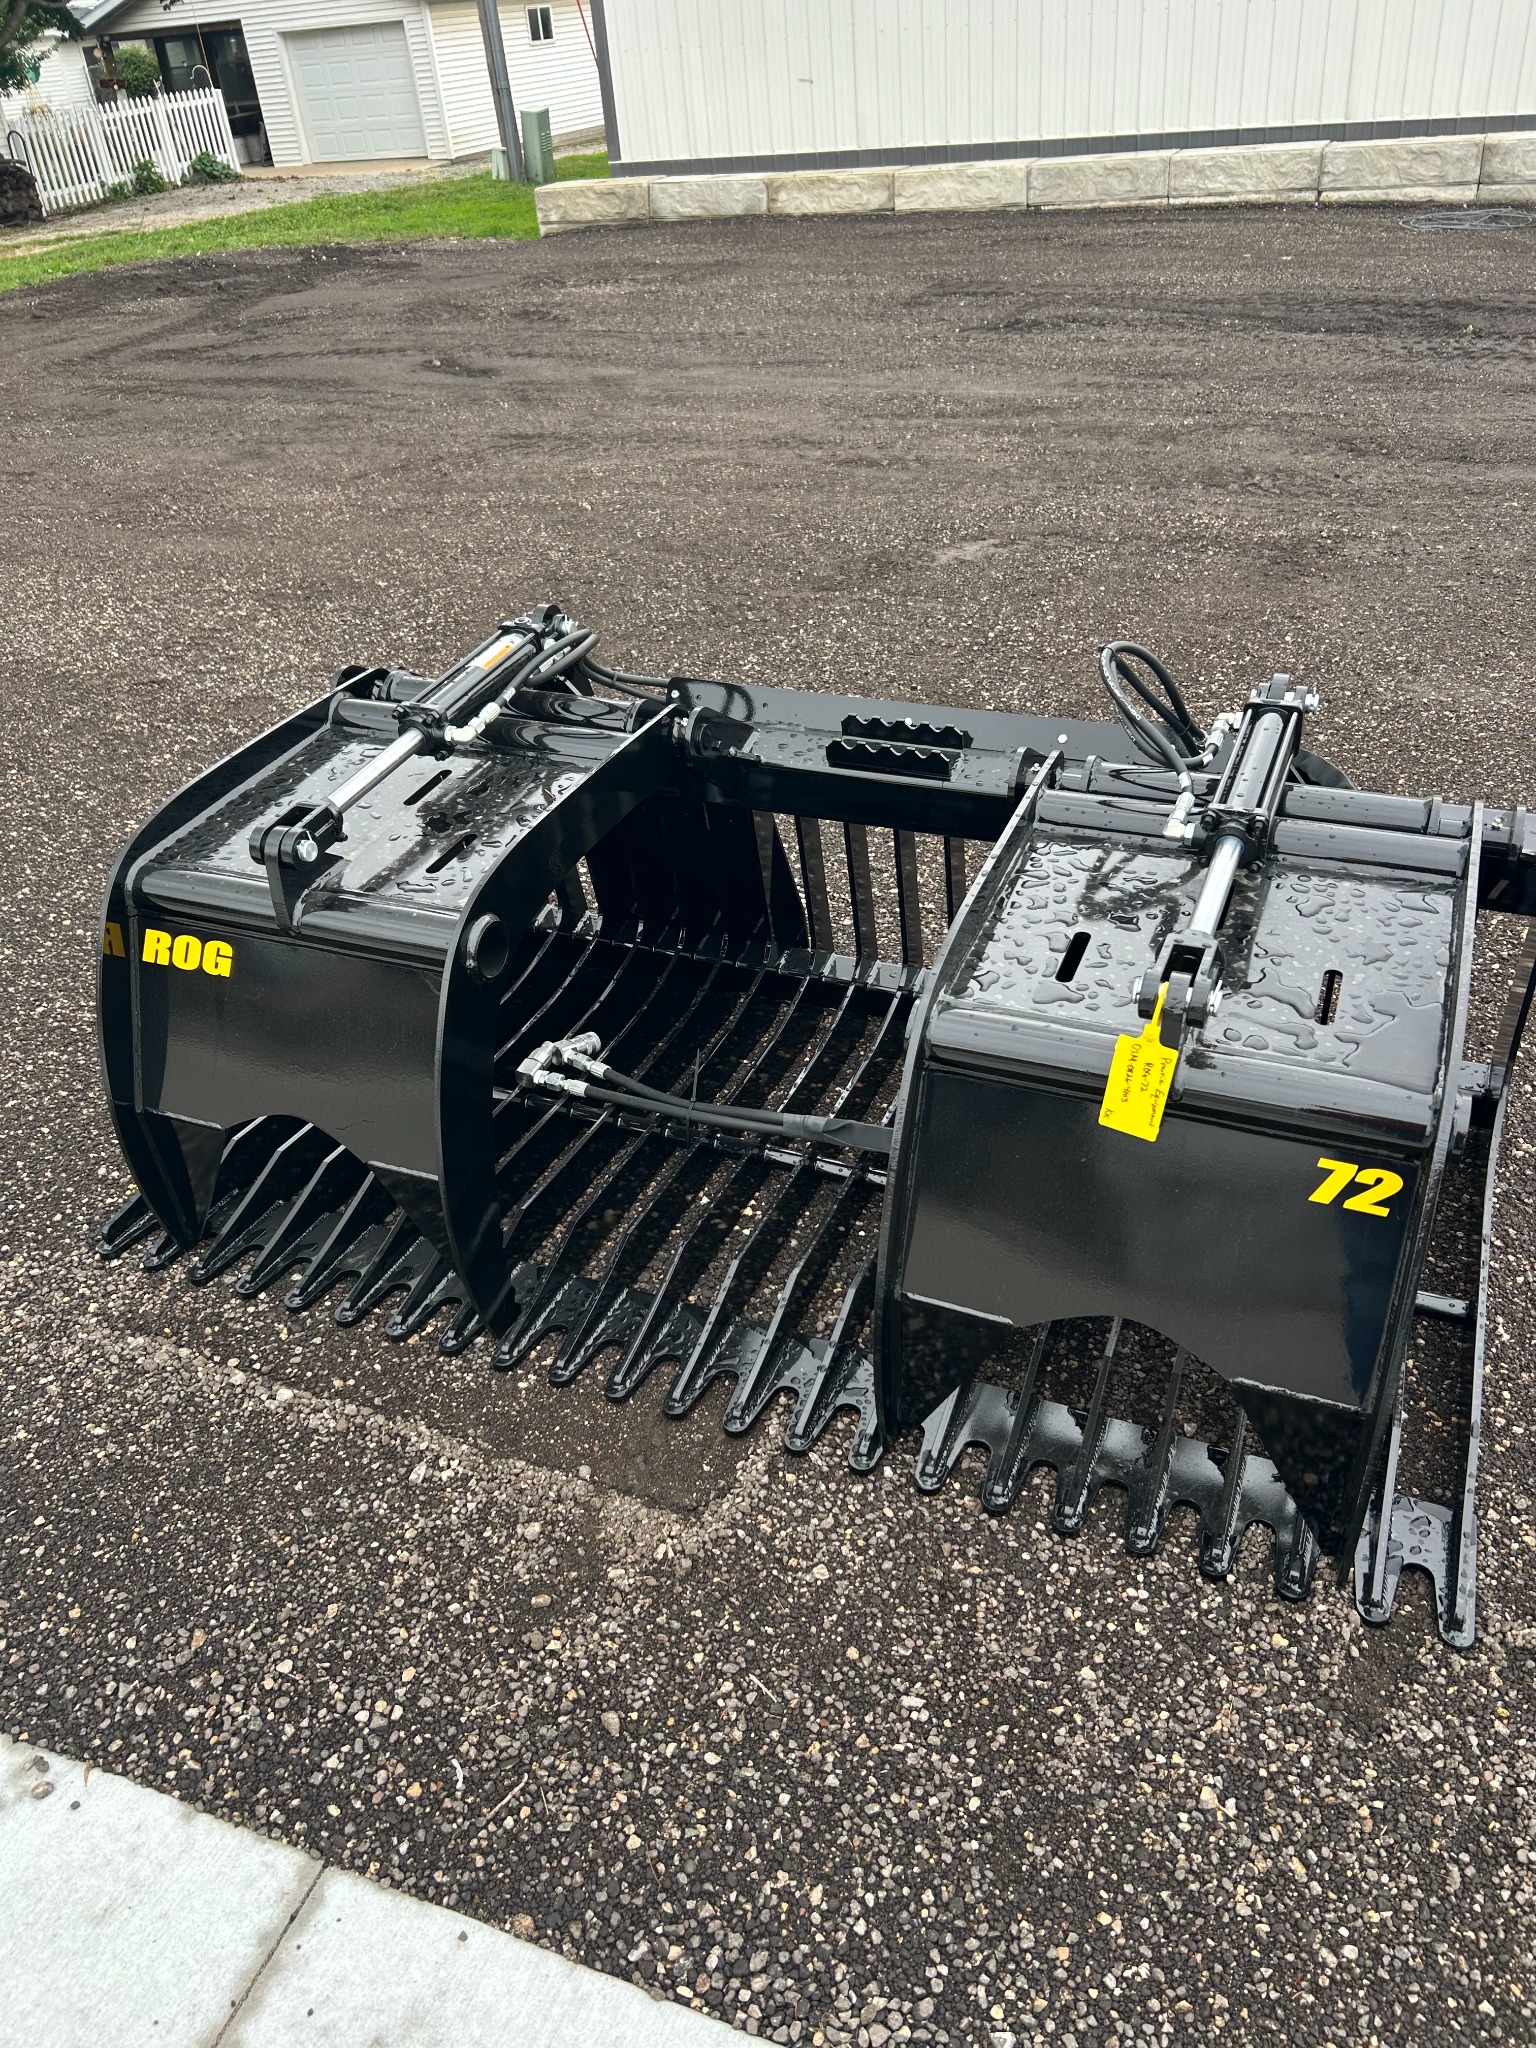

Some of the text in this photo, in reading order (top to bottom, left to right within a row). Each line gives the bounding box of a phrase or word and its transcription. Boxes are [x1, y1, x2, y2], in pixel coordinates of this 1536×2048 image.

[142, 928, 233, 978] ROG
[1159, 1057, 1173, 1085] Prairie
[1308, 1157, 1404, 1218] 72
